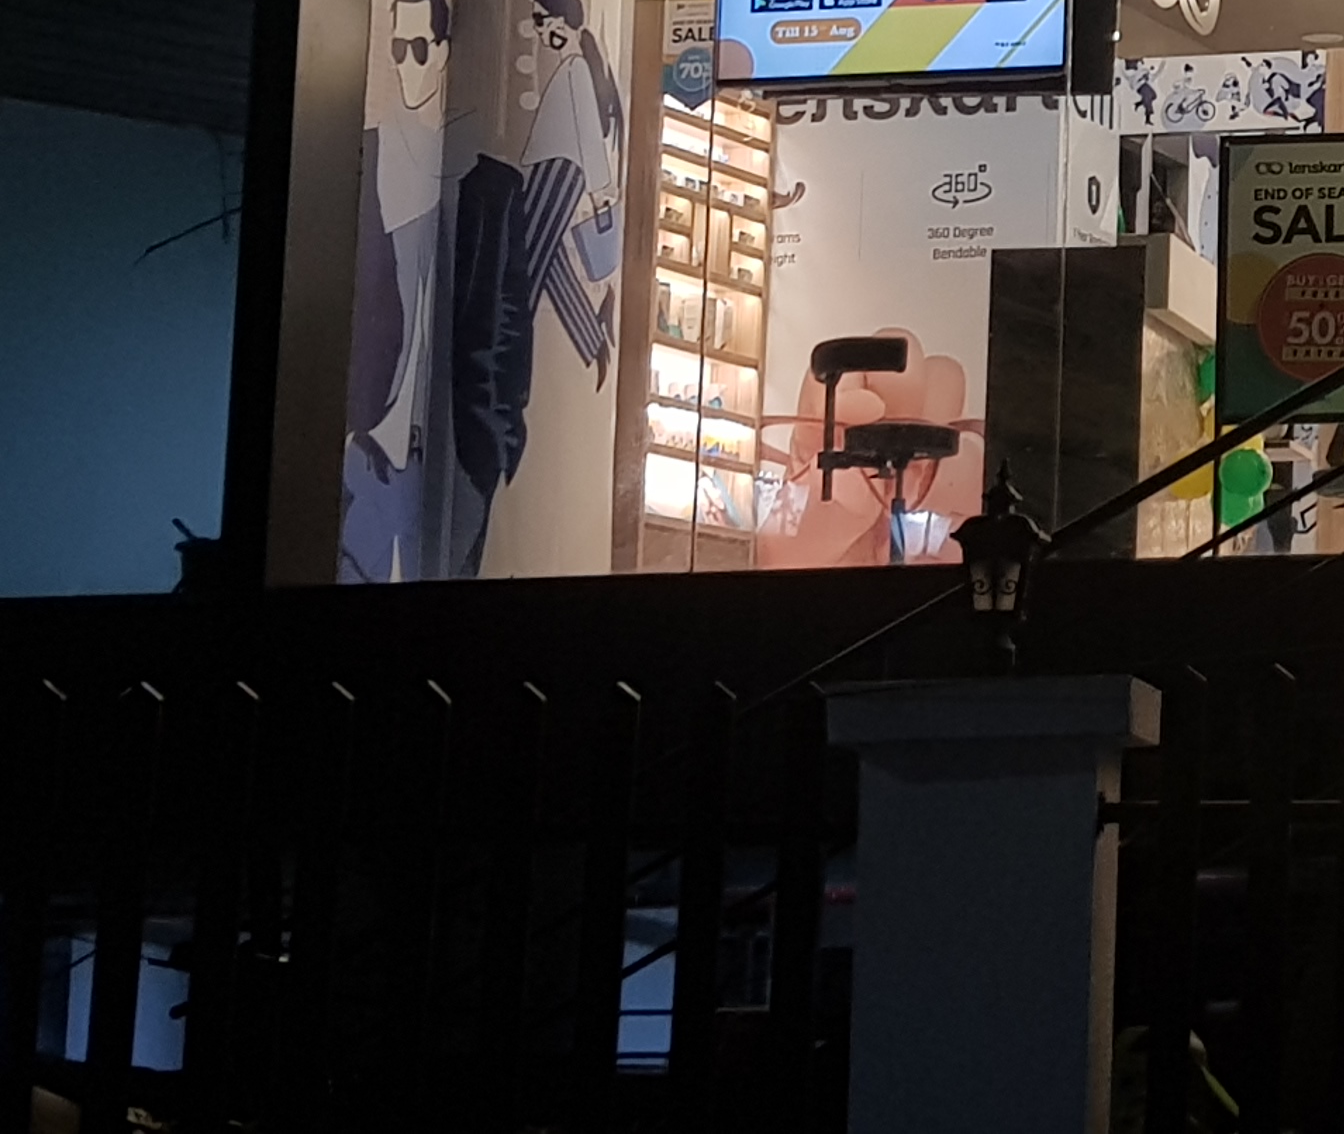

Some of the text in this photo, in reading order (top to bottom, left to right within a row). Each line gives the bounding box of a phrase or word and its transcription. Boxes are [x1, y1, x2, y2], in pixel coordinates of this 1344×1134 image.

[775, 26, 799, 38] Till
[830, 24, 856, 38] Aug
[1253, 188, 1288, 201] END
[1292, 187, 1314, 200] OF
[927, 225, 994, 241] 360 Degree
[932, 246, 988, 261] Bendable
